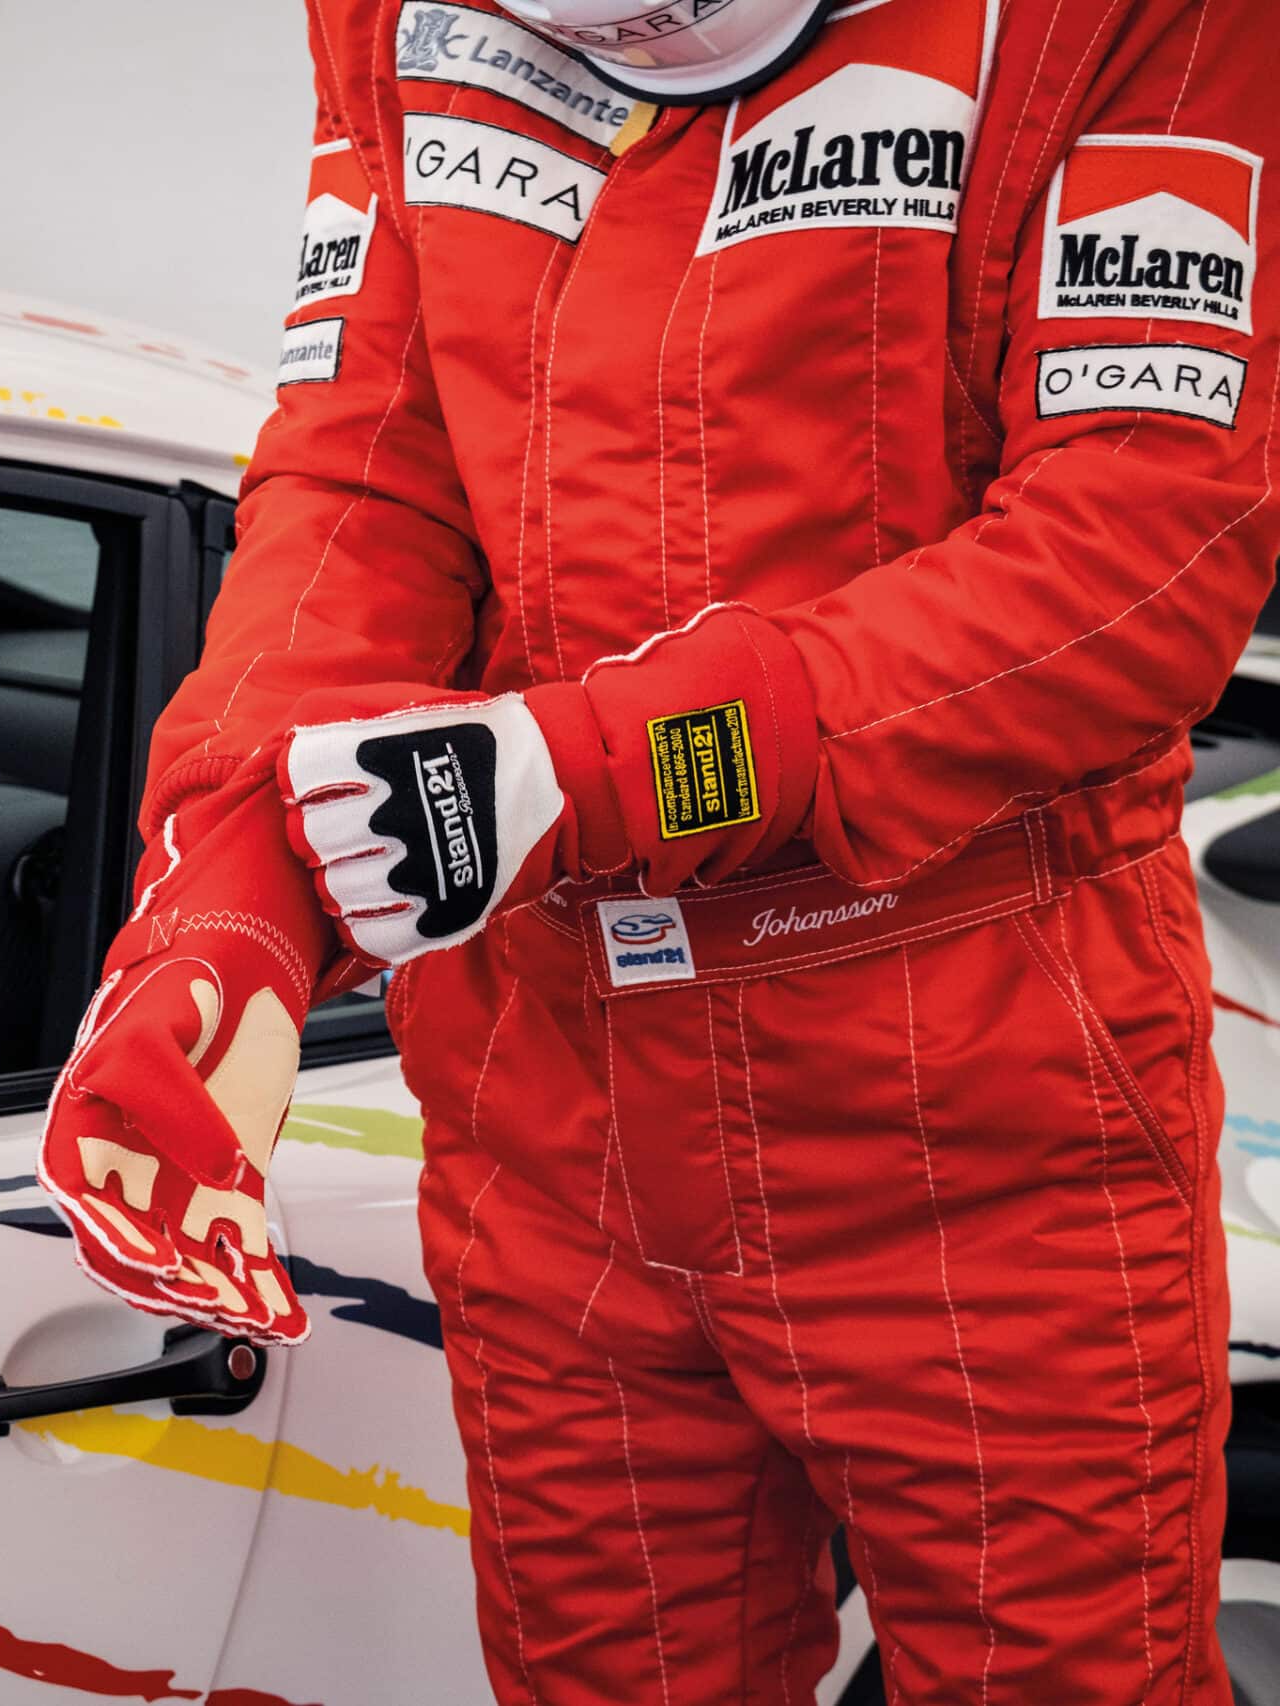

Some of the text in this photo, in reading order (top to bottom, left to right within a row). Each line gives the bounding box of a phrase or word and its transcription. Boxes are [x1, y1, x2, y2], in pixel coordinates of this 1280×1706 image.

[556, 0, 722, 38] 'GARA
[468, 35, 630, 128] Lanzante
[406, 137, 584, 221] 'GARA
[718, 125, 965, 220] McLaren
[716, 198, 955, 241] McLAREN BEVERLY HILLS
[297, 232, 361, 282] Laren
[1056, 234, 1244, 303] McLaren
[1057, 294, 1239, 320] McLAREN BEVERLY HILLS
[1045, 362, 1234, 408] O'GARA
[655, 722, 667, 741] FIA
[679, 777, 693, 822] Standard
[743, 890, 899, 947] Johansson
